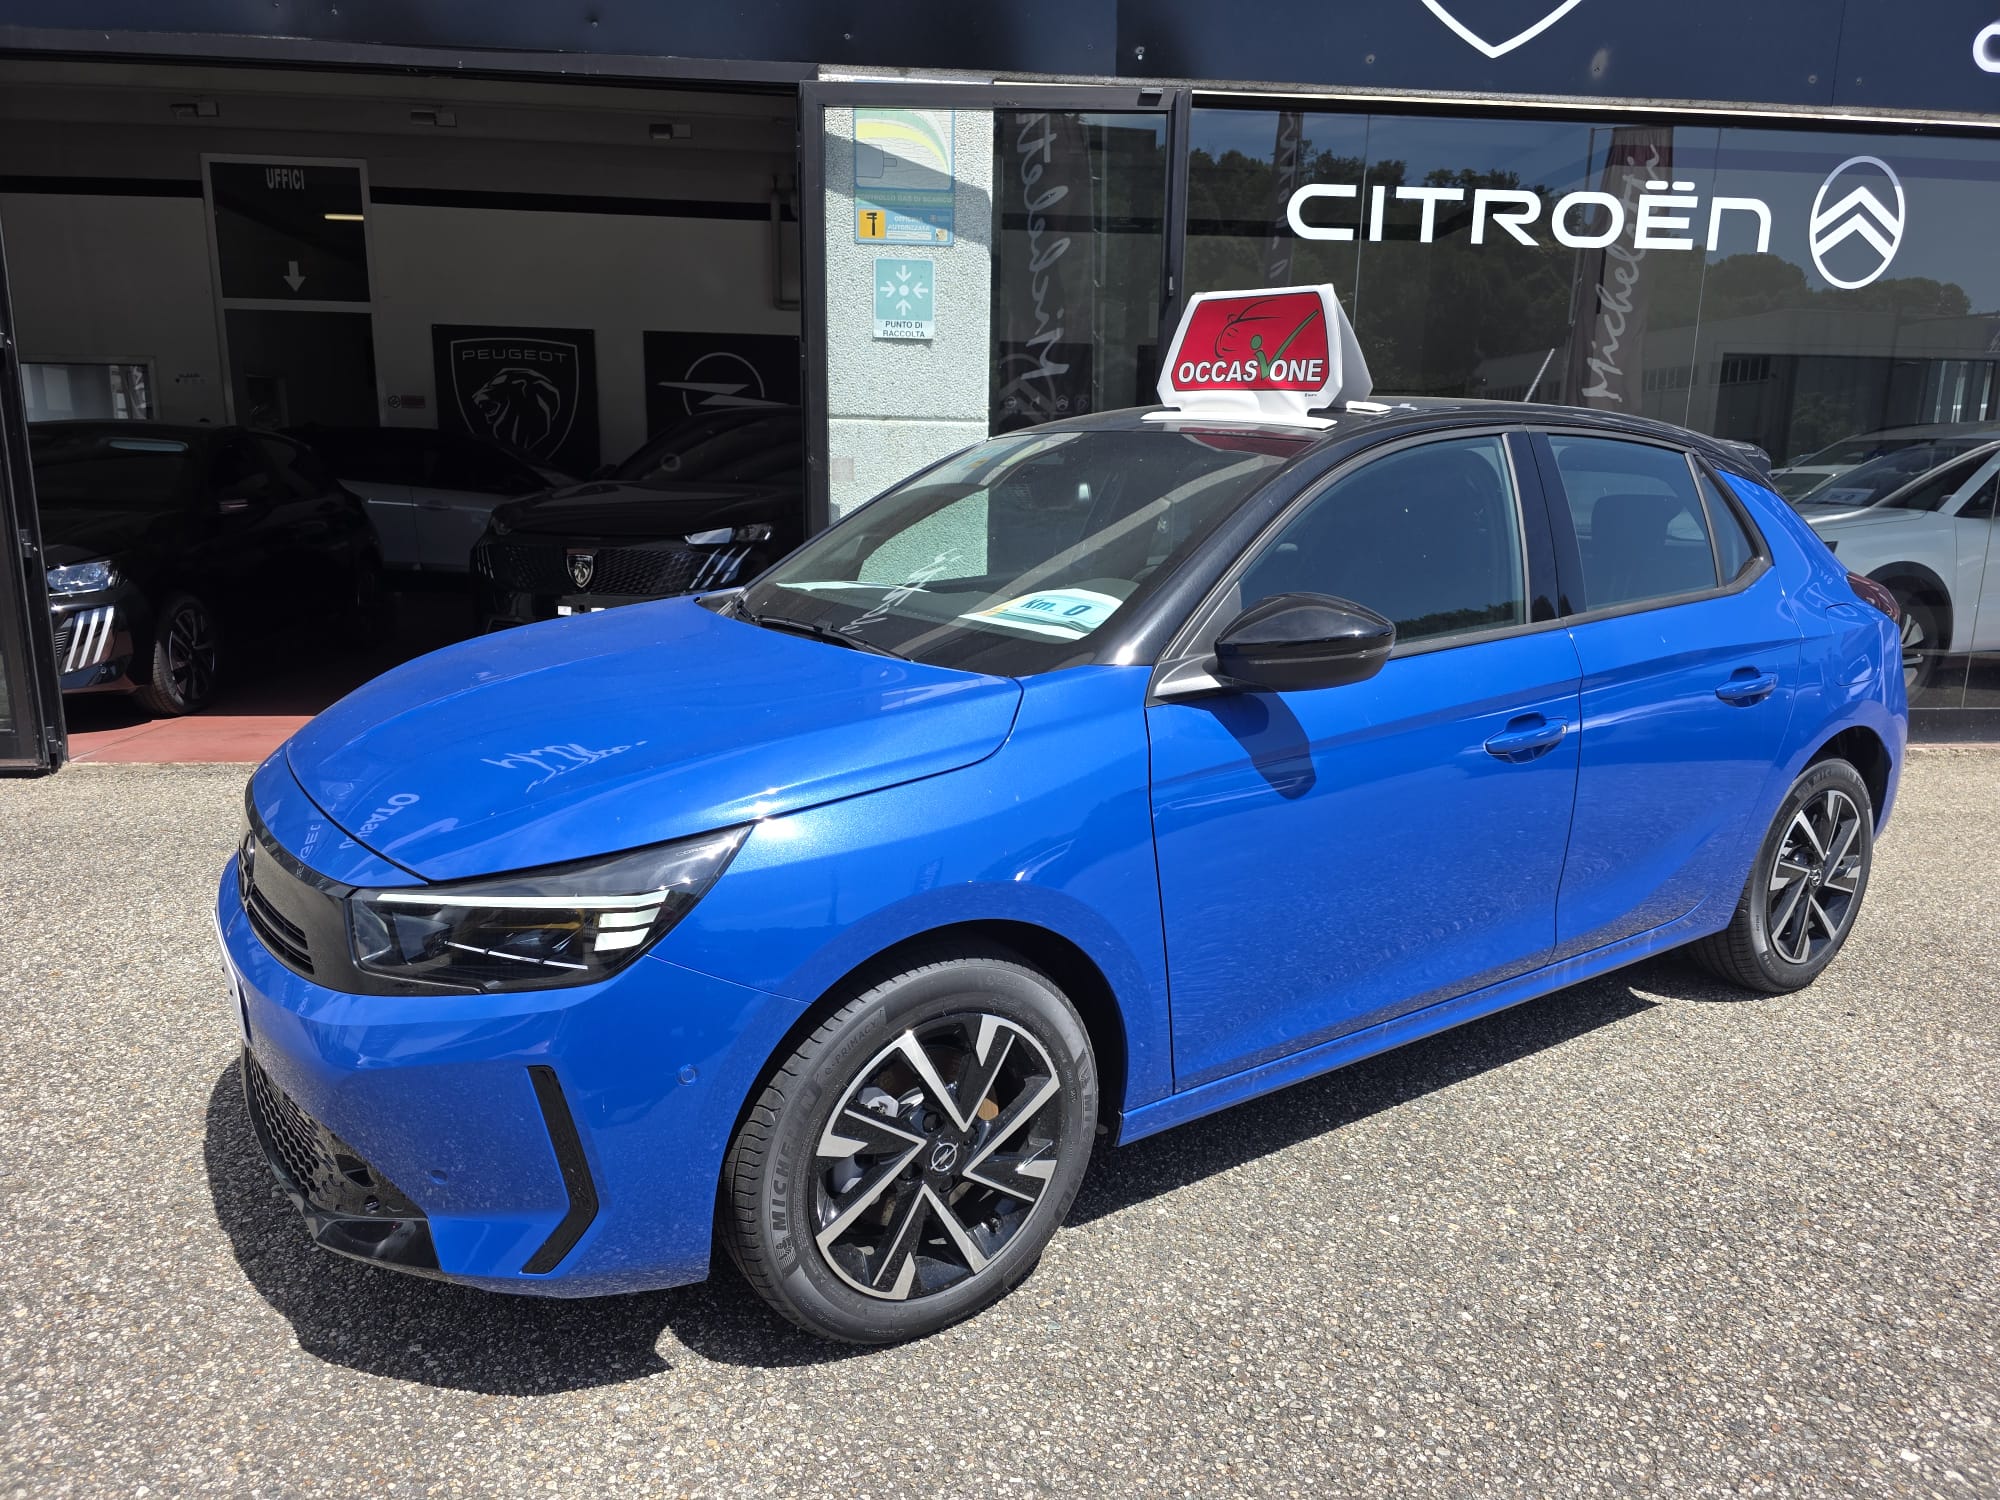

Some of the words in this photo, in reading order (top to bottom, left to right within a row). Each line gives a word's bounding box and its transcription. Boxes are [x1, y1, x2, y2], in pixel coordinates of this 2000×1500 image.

[265, 167, 304, 190] UFFICI
[882, 329, 925, 338] RACCOLTA
[885, 320, 913, 329] PUNTO
[914, 321, 923, 329] DI
[462, 348, 568, 363] PEUGEOT
[1178, 347, 1324, 384] OCCASIONE
[772, 1088, 818, 1232] MICHEN
